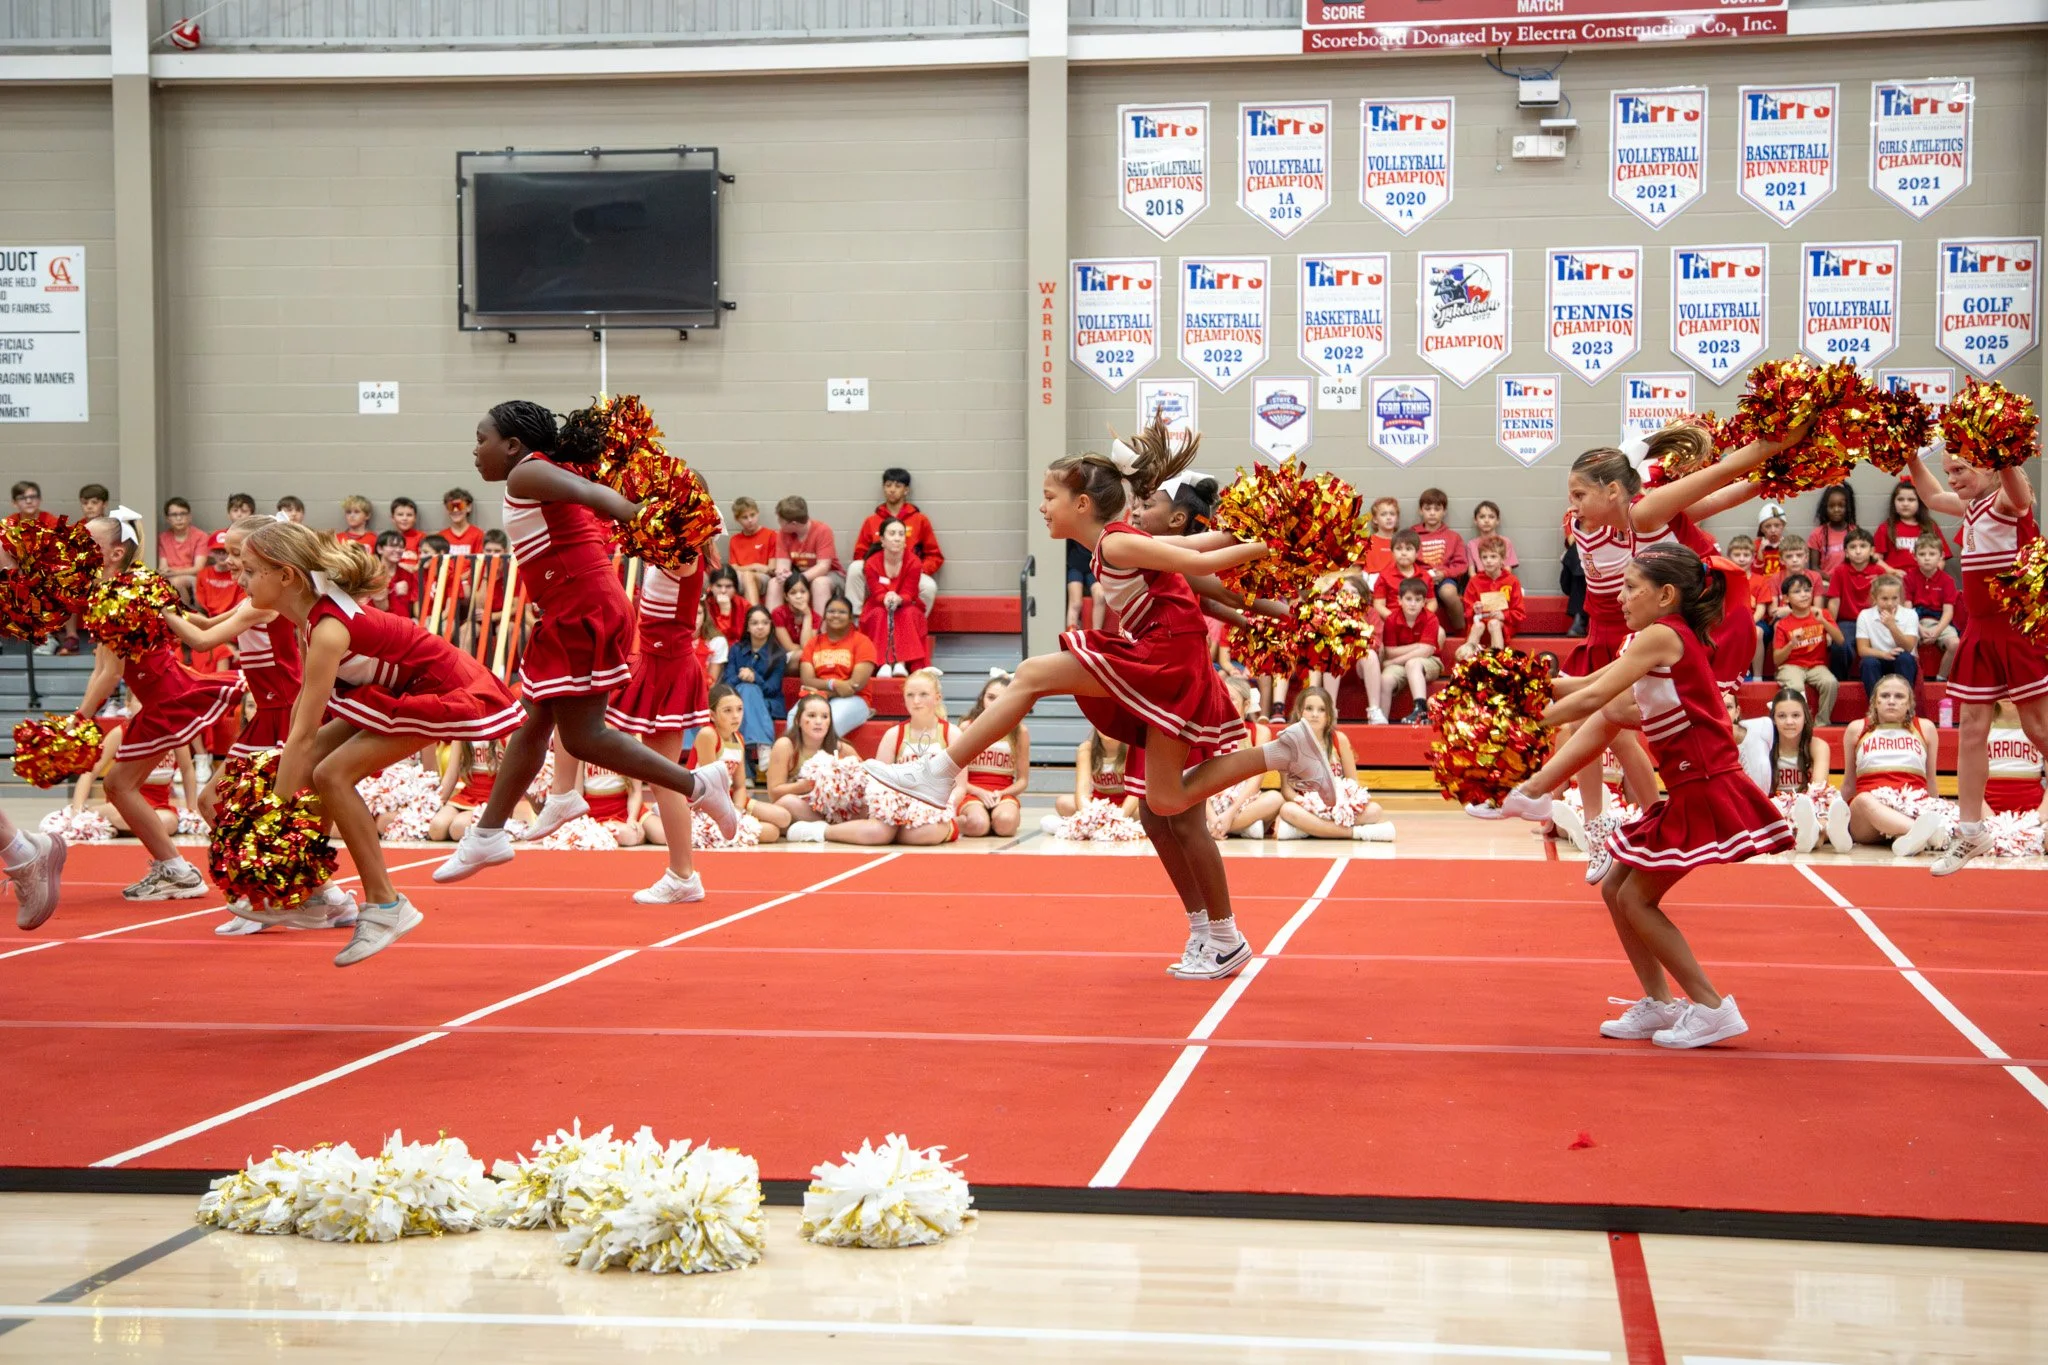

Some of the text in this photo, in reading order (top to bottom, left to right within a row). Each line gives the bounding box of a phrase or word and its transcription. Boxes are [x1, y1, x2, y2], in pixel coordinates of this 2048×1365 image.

[1322, 6, 1365, 20] SCORE
[1517, 0, 1564, 12] MATCH
[1312, 31, 1407, 49] Scoreboard
[1413, 28, 1486, 44] Donated
[1491, 27, 1512, 45] by
[1517, 26, 1577, 41] Electra
[1582, 20, 1696, 38] Construction
[1743, 16, 1777, 31] Inc.
[1746, 143, 1828, 161] BASKETBALL
[1879, 138, 1963, 154] GIRLS ATHLETICS
[1618, 146, 1696, 163] VOLLEYBALL
[1149, 161, 1203, 177] VOLLEYBALL
[1249, 160, 1321, 175] VOLLEYBALL
[1368, 157, 1444, 171] VOLLEYBALL
[1744, 159, 1831, 179] RUNNERUP
[1877, 153, 1961, 171] CHAMPION
[1615, 163, 1698, 181] CHAMPION
[1126, 179, 1203, 195] CHAMPIONS
[1245, 176, 1325, 194] CHAMPION
[1365, 172, 1446, 189] CHAMPION
[1899, 176, 1939, 190] 2021
[1637, 185, 1676, 198] 2021
[1766, 182, 1806, 196] 2021
[1279, 193, 1295, 205] 1A
[1386, 192, 1426, 205] 2020
[1779, 200, 1796, 211] 1A
[1912, 196, 1929, 207] 1A
[1147, 200, 1183, 216] 2018
[1269, 207, 1302, 219] 2018
[1399, 209, 1413, 219] 1A
[1649, 203, 1665, 213] 1A
[15, 277, 36, 287] HELD
[1554, 304, 1633, 320] TENNIS
[1679, 302, 1760, 319] VOLLEYBALL
[1808, 300, 1891, 317] VOLLEYBALL
[1963, 296, 2013, 314] GOLF
[1078, 314, 1151, 329] VOLLEYBALL
[1186, 313, 1261, 328] BASKETBALL
[1306, 310, 1380, 325] BASKETBALL
[1942, 313, 2032, 332] CHAMPION
[1552, 320, 1632, 337] CHAMPION
[1677, 318, 1760, 336] CHAMPION
[1807, 316, 1892, 335] CHAMPION
[1076, 329, 1152, 346] CHAMPION
[1185, 329, 1263, 345] CHAMPIONS
[1304, 325, 1383, 343] CHAMPIONS
[1038, 281, 1057, 406] WARRIORS
[1423, 335, 1503, 352] CHAMPION
[1572, 341, 1613, 355] 2023
[1699, 340, 1740, 354] 2023
[1828, 338, 1870, 352] 2024
[1965, 335, 2009, 350] 2025
[1096, 350, 1134, 363] 2022
[1204, 349, 1242, 362] 2022
[1324, 346, 1363, 359] 2022
[1979, 353, 1996, 365] 1A
[1337, 364, 1352, 374] 1A
[1585, 359, 1601, 370] 1A
[1712, 358, 1729, 369] 1A
[34, 372, 75, 384] MANNER
[1108, 367, 1124, 378] 1A
[1216, 367, 1231, 377] 1A
[363, 391, 395, 400] GRADE
[832, 388, 865, 397] GRADE
[1322, 386, 1357, 395] GRADE
[1336, 395, 1343, 404] 3
[1503, 408, 1553, 419] DISTRICT
[1628, 408, 1688, 420] REGIONAL
[1504, 419, 1554, 430] TENNIS
[1629, 419, 1654, 430] TACK
[1379, 433, 1429, 445] RUNNER-UP
[1502, 430, 1554, 441] CHAMPION
[1862, 736, 1922, 756] WARRIORS
[1987, 741, 2038, 763] ARRIORS
[971, 751, 1015, 769] ARRIORS
